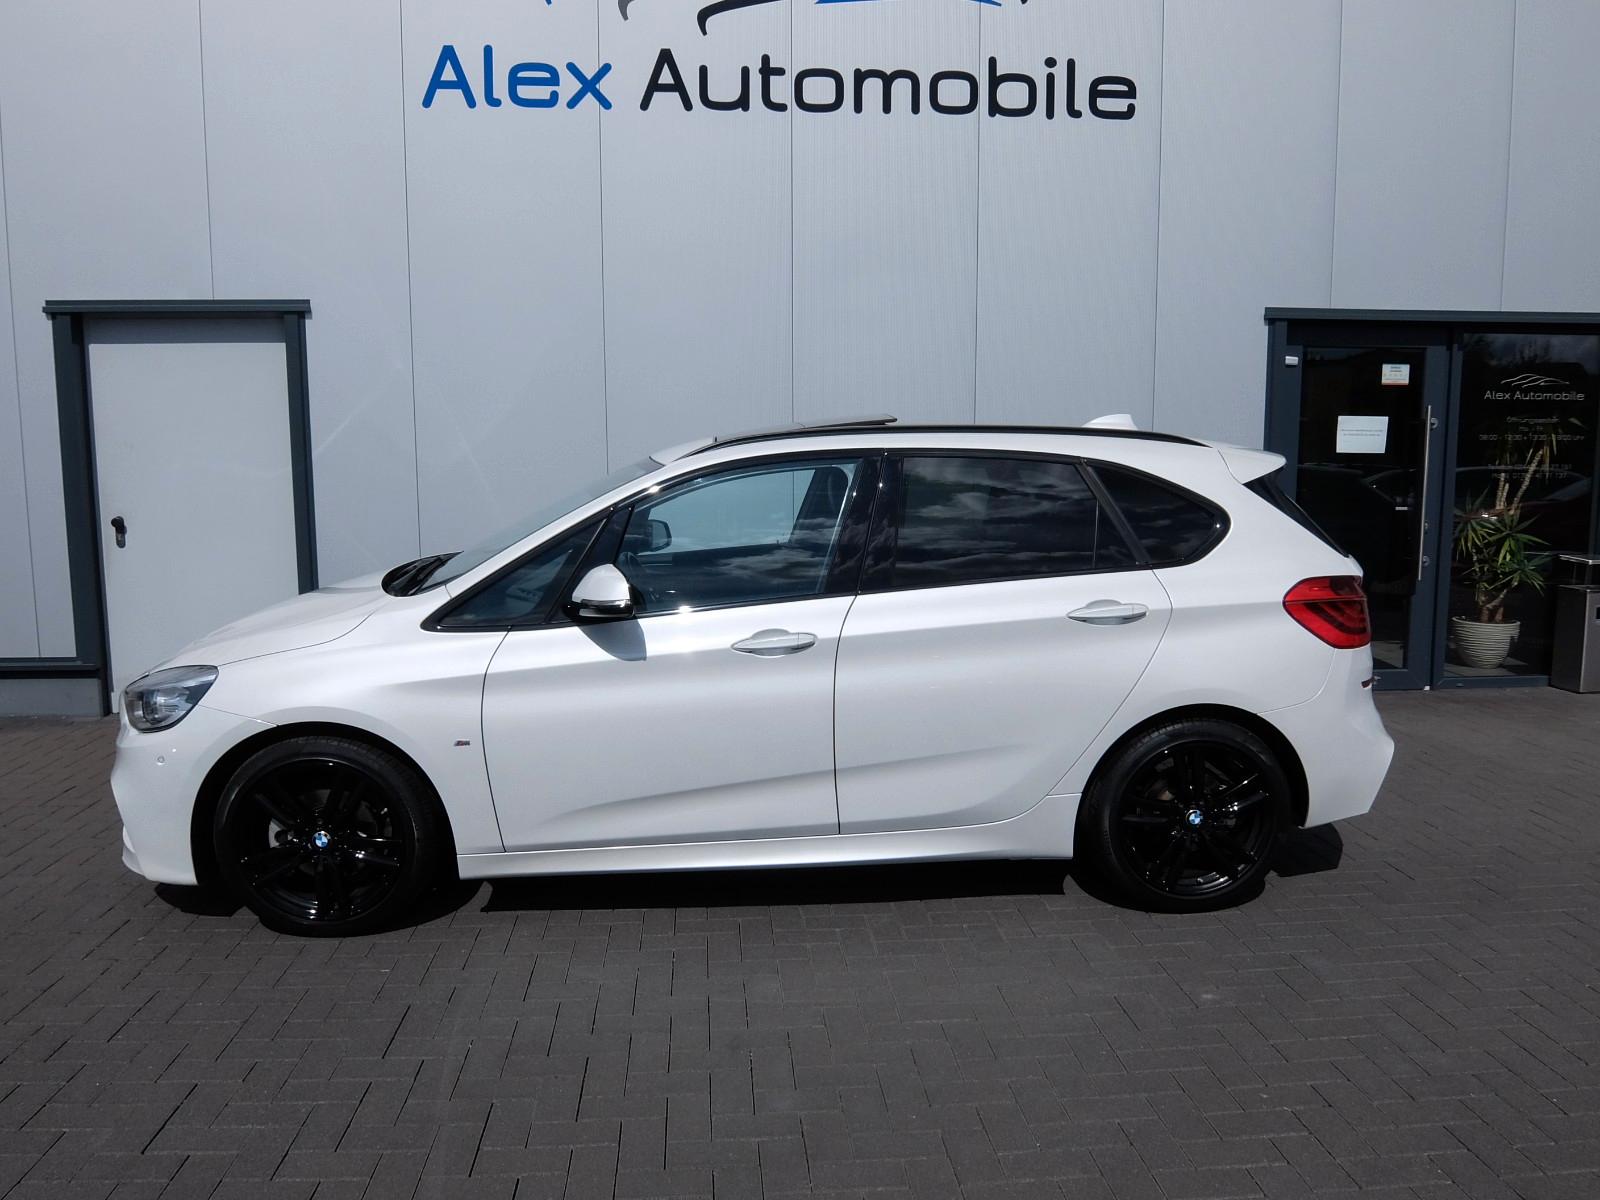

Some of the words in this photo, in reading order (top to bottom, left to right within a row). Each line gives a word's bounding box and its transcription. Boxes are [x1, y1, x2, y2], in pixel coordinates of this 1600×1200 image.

[421, 44, 613, 111] Alex
[639, 48, 1137, 121] Automobile
[1483, 390, 1511, 400] Alex
[1513, 391, 1585, 401] Automobile
